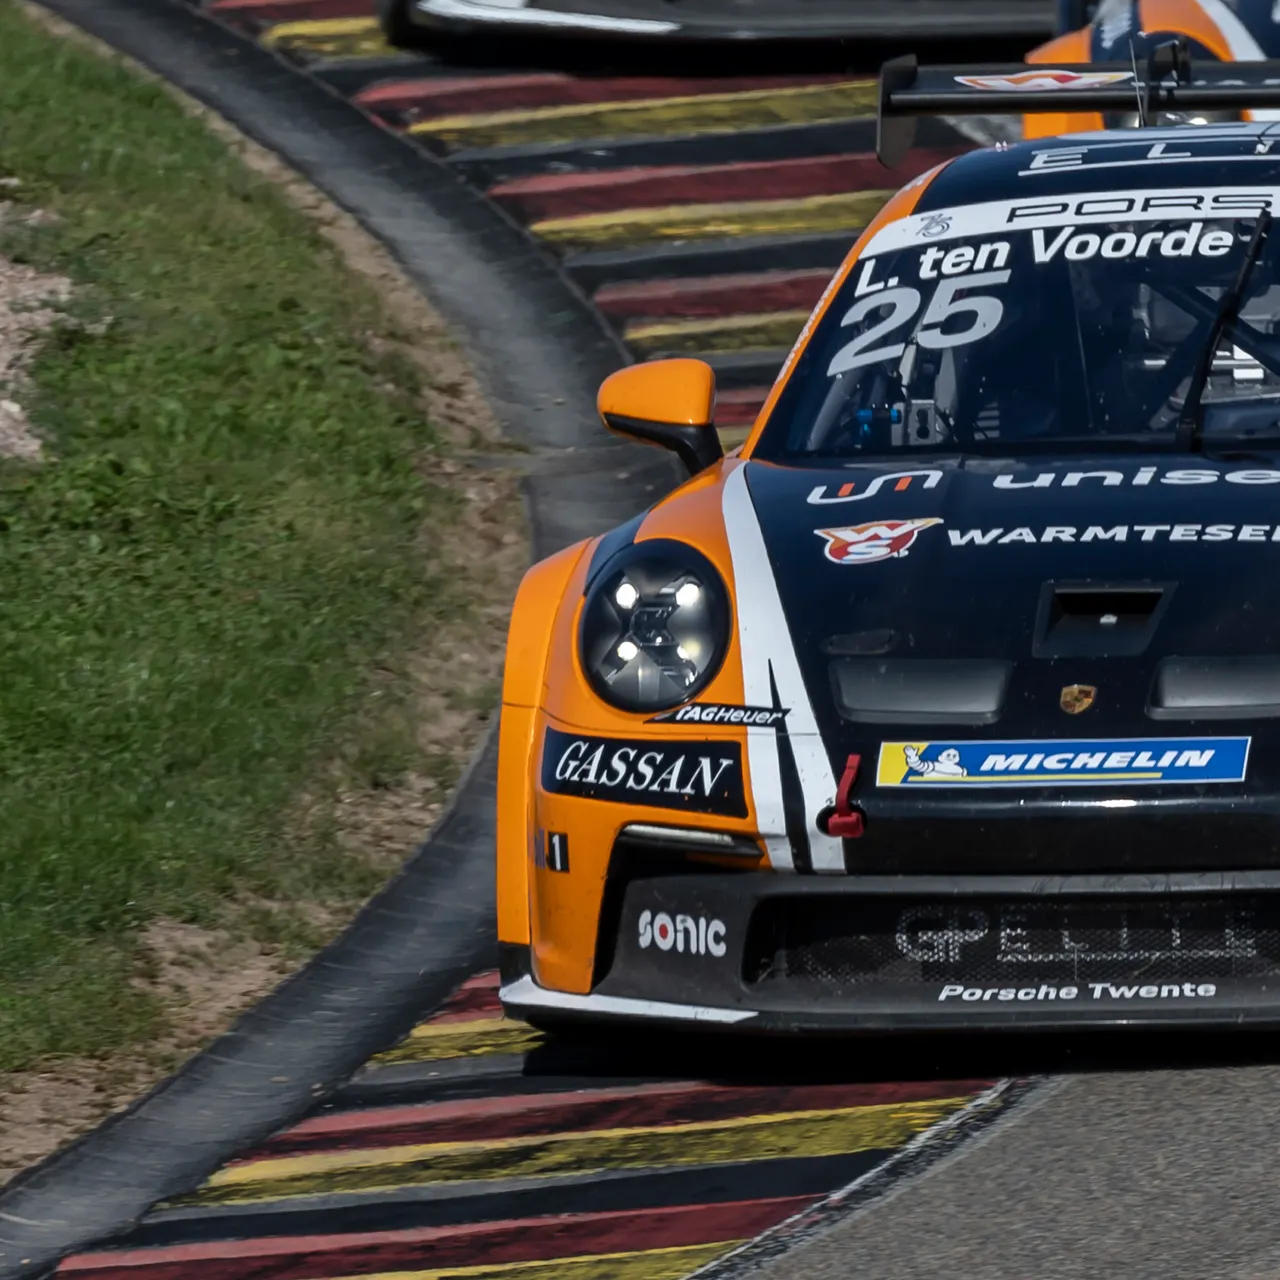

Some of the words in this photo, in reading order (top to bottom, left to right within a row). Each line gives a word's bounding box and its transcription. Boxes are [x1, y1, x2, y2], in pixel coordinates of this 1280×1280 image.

[854, 257, 900, 298] L.
[918, 240, 1012, 281] ten
[1031, 222, 1235, 264] Voorde
[826, 268, 1013, 377] 25
[554, 740, 734, 799] GASSAN
[979, 746, 1215, 773] MICHELIN
[937, 983, 1079, 1001] Porsche
[1088, 981, 1217, 999] Twente
